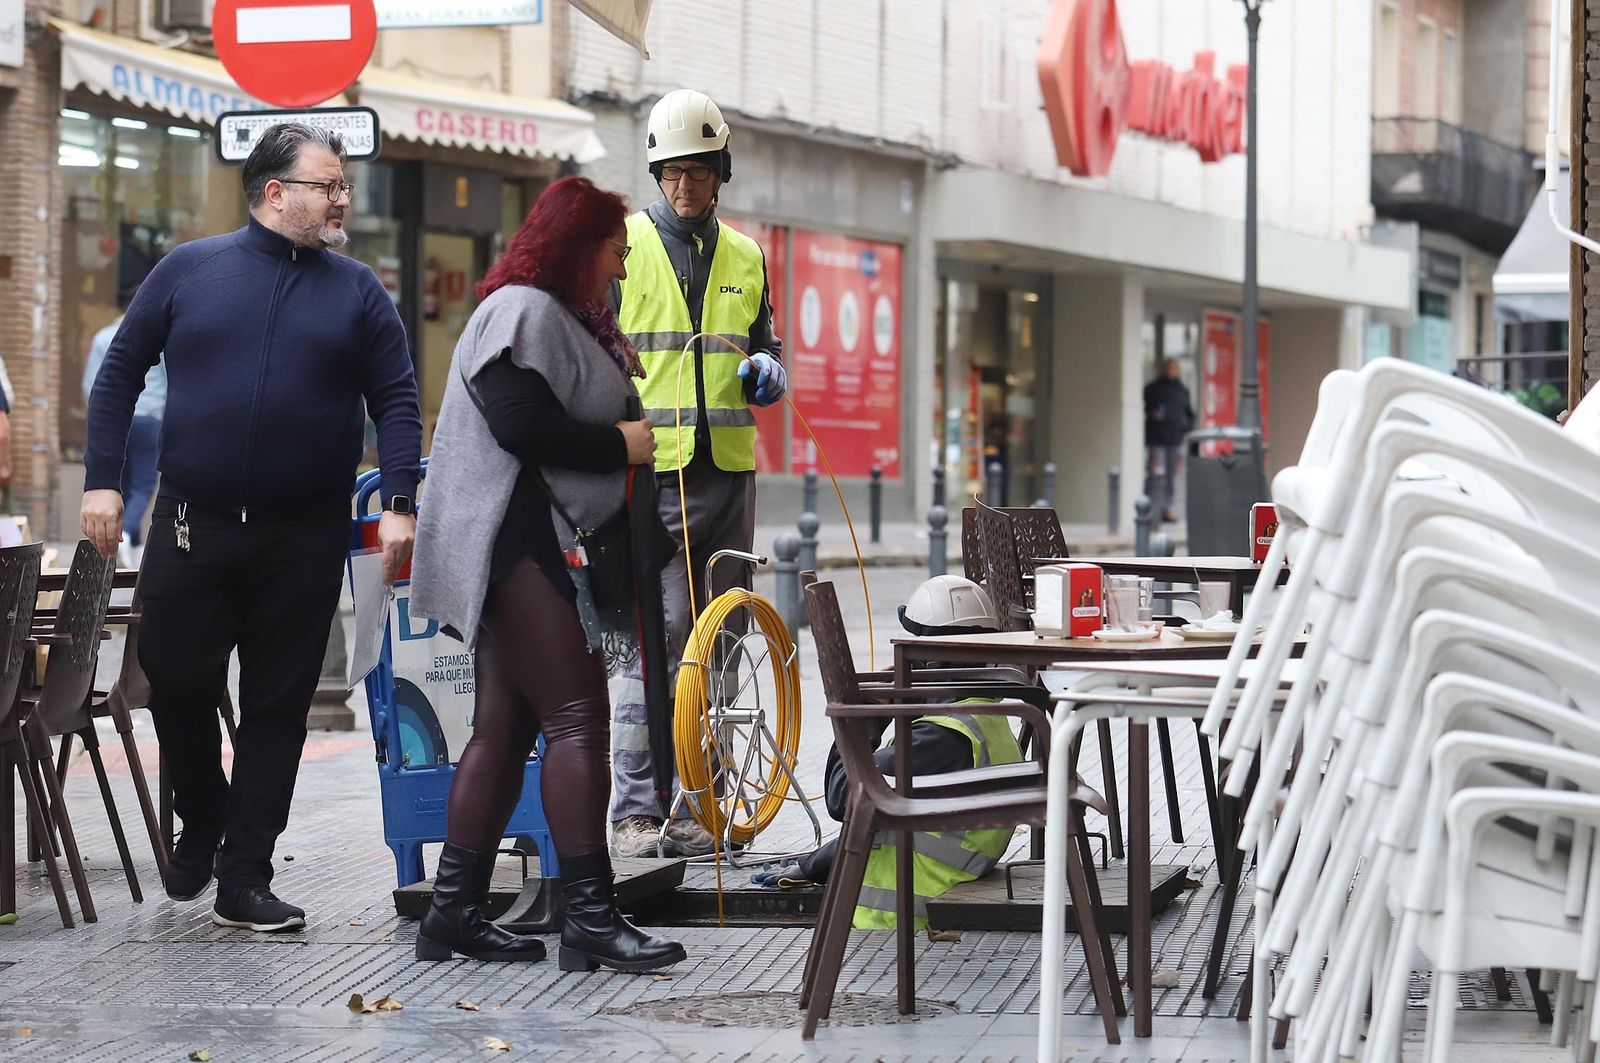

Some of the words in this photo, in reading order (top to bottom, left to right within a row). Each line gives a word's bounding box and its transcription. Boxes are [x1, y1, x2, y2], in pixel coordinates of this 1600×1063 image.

[310, 115, 367, 130] RESIDENTES
[416, 108, 537, 145] CASERO
[720, 285, 743, 294] DIGI
[434, 654, 469, 668] ESTAMOS
[426, 670, 445, 683] PARA
[446, 669, 461, 681] QUE
[463, 668, 473, 680] NU
[455, 682, 475, 694] LLEGU
